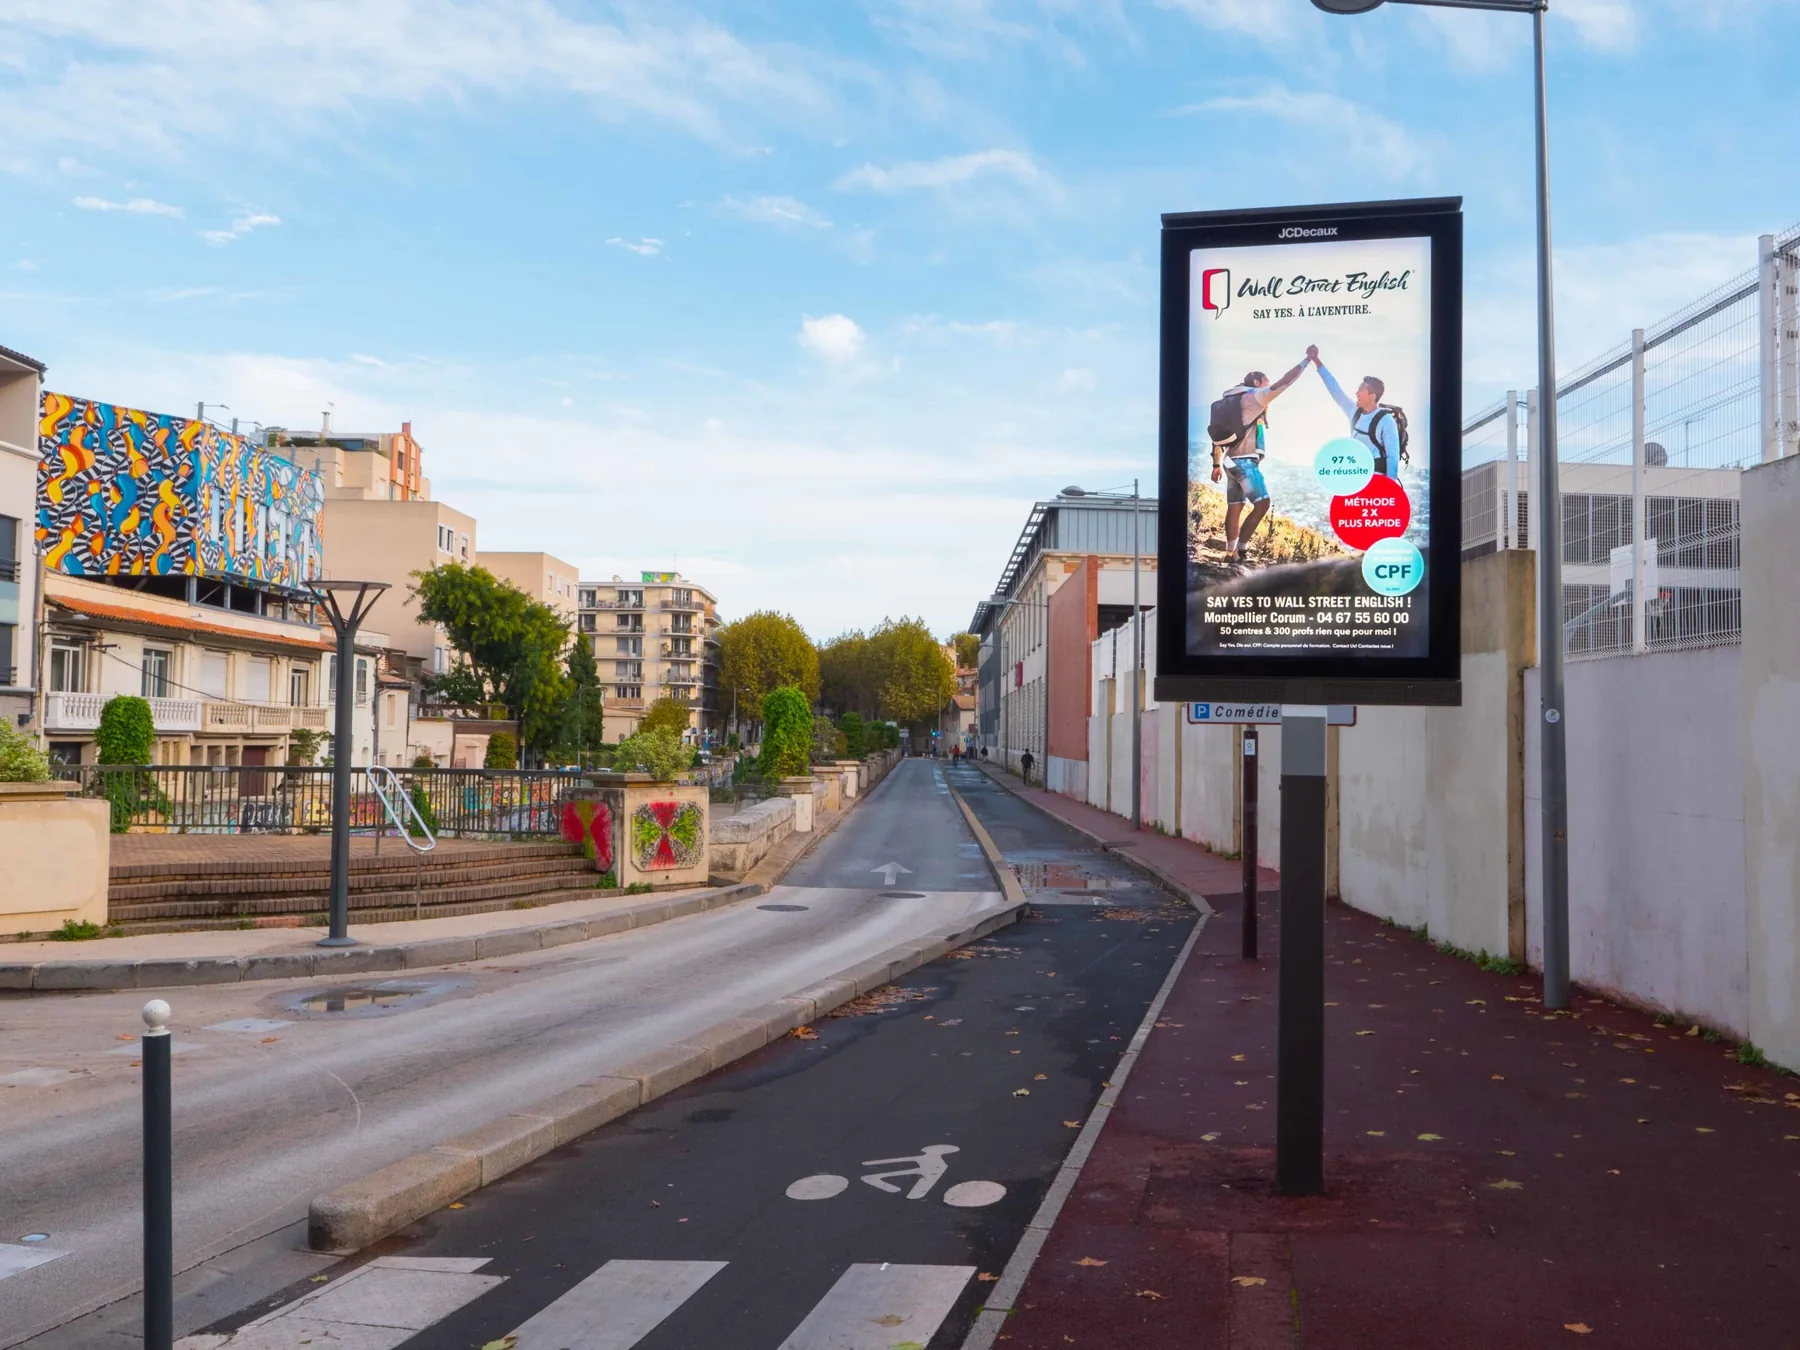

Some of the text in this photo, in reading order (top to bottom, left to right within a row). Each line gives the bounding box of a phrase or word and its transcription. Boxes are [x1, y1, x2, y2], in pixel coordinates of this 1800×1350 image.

[1278, 227, 1338, 238] JCDecaux
[1237, 269, 1411, 299] Wall Street English
[1253, 309, 1271, 319] SAY
[1274, 308, 1296, 318] YES.
[1298, 304, 1305, 317] À
[1331, 455, 1356, 464] 97 %
[1318, 466, 1369, 476] de réussite
[1344, 496, 1396, 507] MÉTHODE
[1361, 508, 1378, 517] 2 X
[1338, 518, 1402, 528] PLUS RAPIDE
[1374, 564, 1412, 579] CPF
[1206, 596, 1412, 608] SAY YES TO WALL STREET ENGLISH !
[1204, 611, 1268, 626] Montpellier
[1270, 612, 1306, 623] Corum
[1316, 612, 1333, 624] 04
[1335, 612, 1352, 624] 67
[1354, 612, 1371, 624] 55
[1373, 612, 1390, 624] 60
[1393, 612, 1410, 624] 00
[1220, 626, 1397, 637] 50 centres & 300 profs rien que pour moi !
[1215, 705, 1279, 718] Comédie
